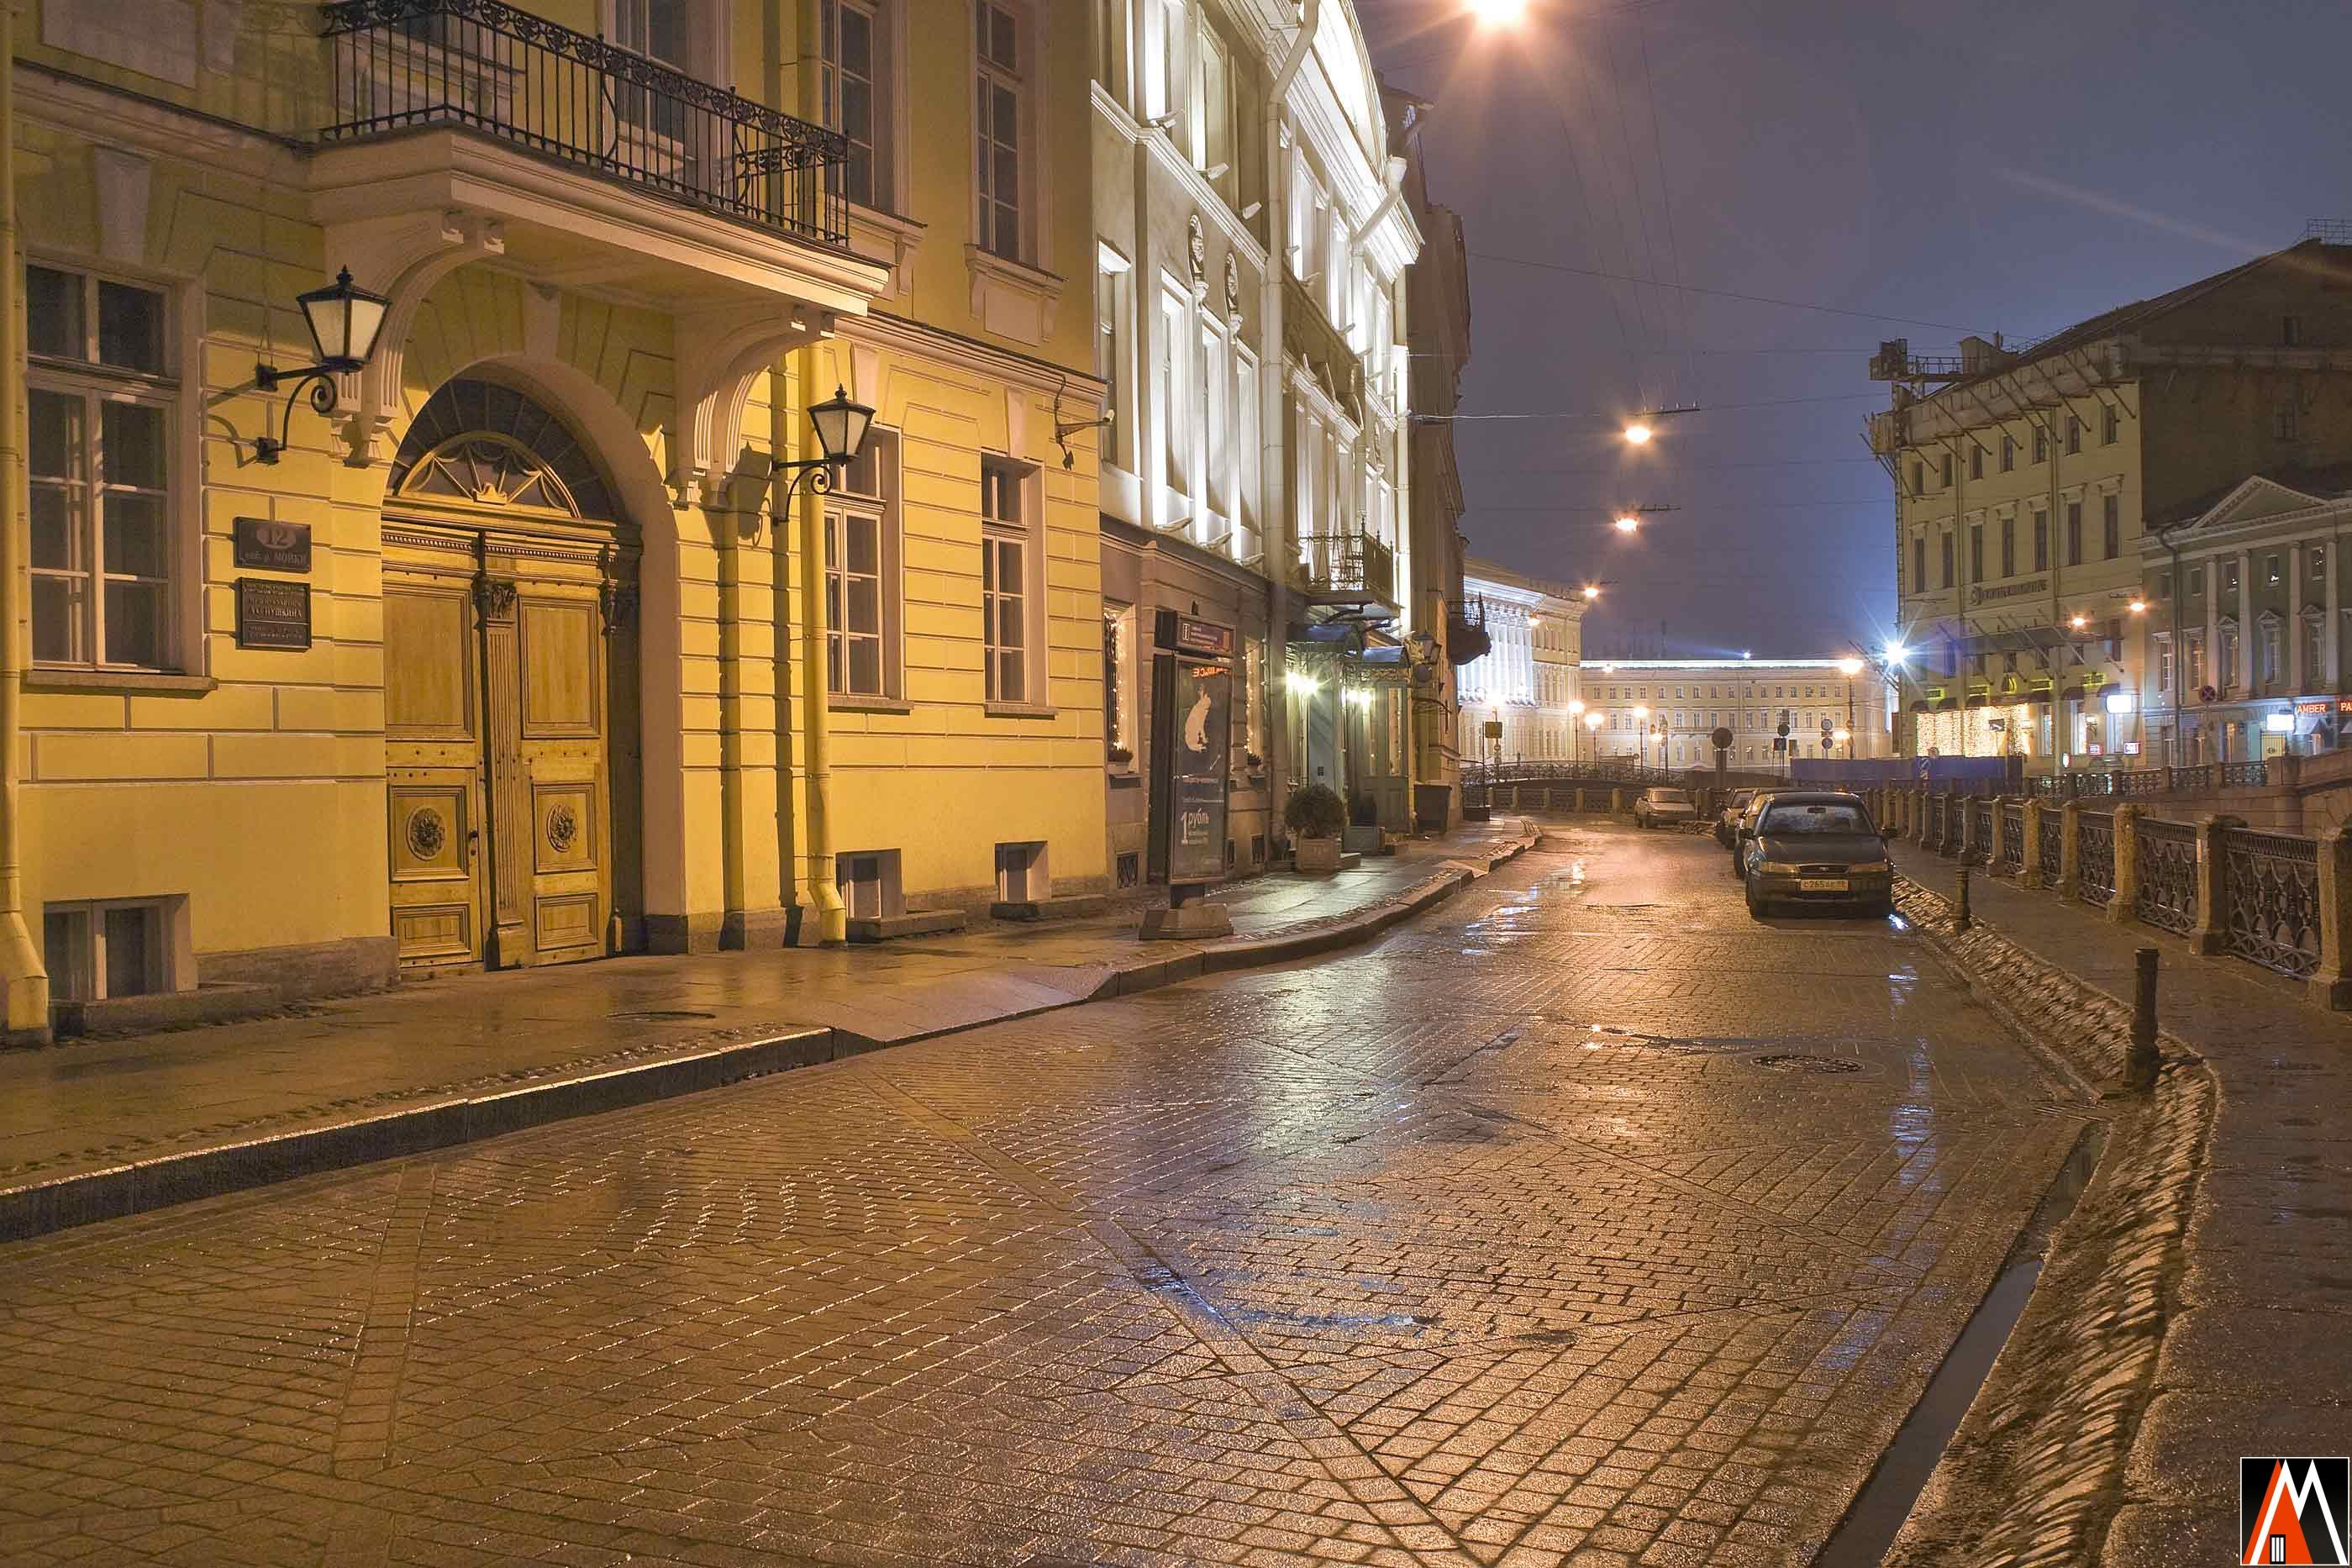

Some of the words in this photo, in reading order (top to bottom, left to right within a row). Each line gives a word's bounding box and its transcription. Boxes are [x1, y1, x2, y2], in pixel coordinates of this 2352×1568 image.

[2297, 703, 2327, 713] AMBER
[1181, 811, 1188, 845] 1
[1188, 808, 1210, 829] рубль
